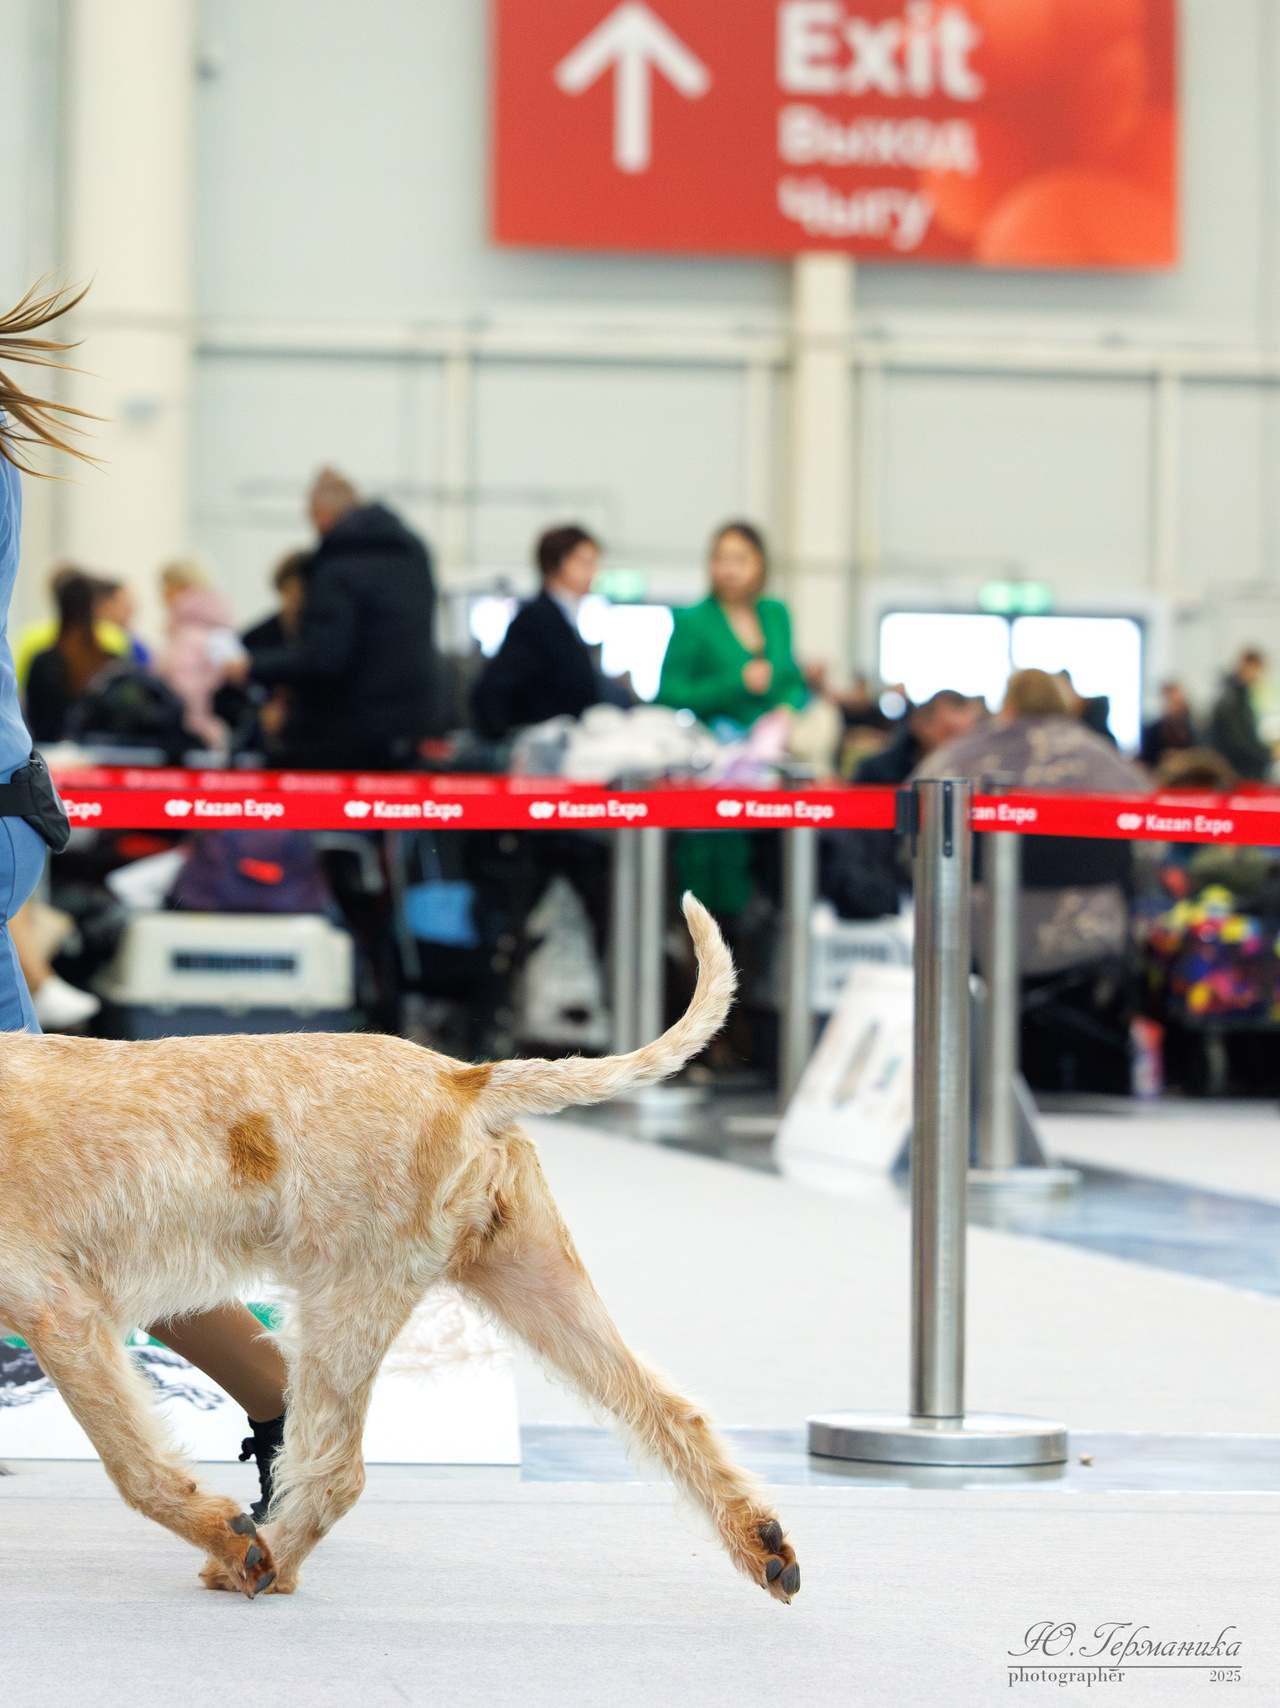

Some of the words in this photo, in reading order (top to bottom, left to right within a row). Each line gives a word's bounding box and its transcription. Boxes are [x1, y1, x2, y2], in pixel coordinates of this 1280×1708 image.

[777, 0, 983, 100] Exit
[195, 799, 242, 817] Kazan
[244, 799, 285, 821] Expo
[374, 800, 421, 819] Kazan
[423, 800, 463, 822] Expo
[558, 801, 606, 818] Kazan
[607, 799, 648, 821] Expo
[745, 801, 793, 818] Kazan
[794, 801, 835, 822] Expo
[997, 803, 1037, 825] Expo
[1145, 814, 1193, 832] Kazan
[1194, 815, 1233, 836] Expo
